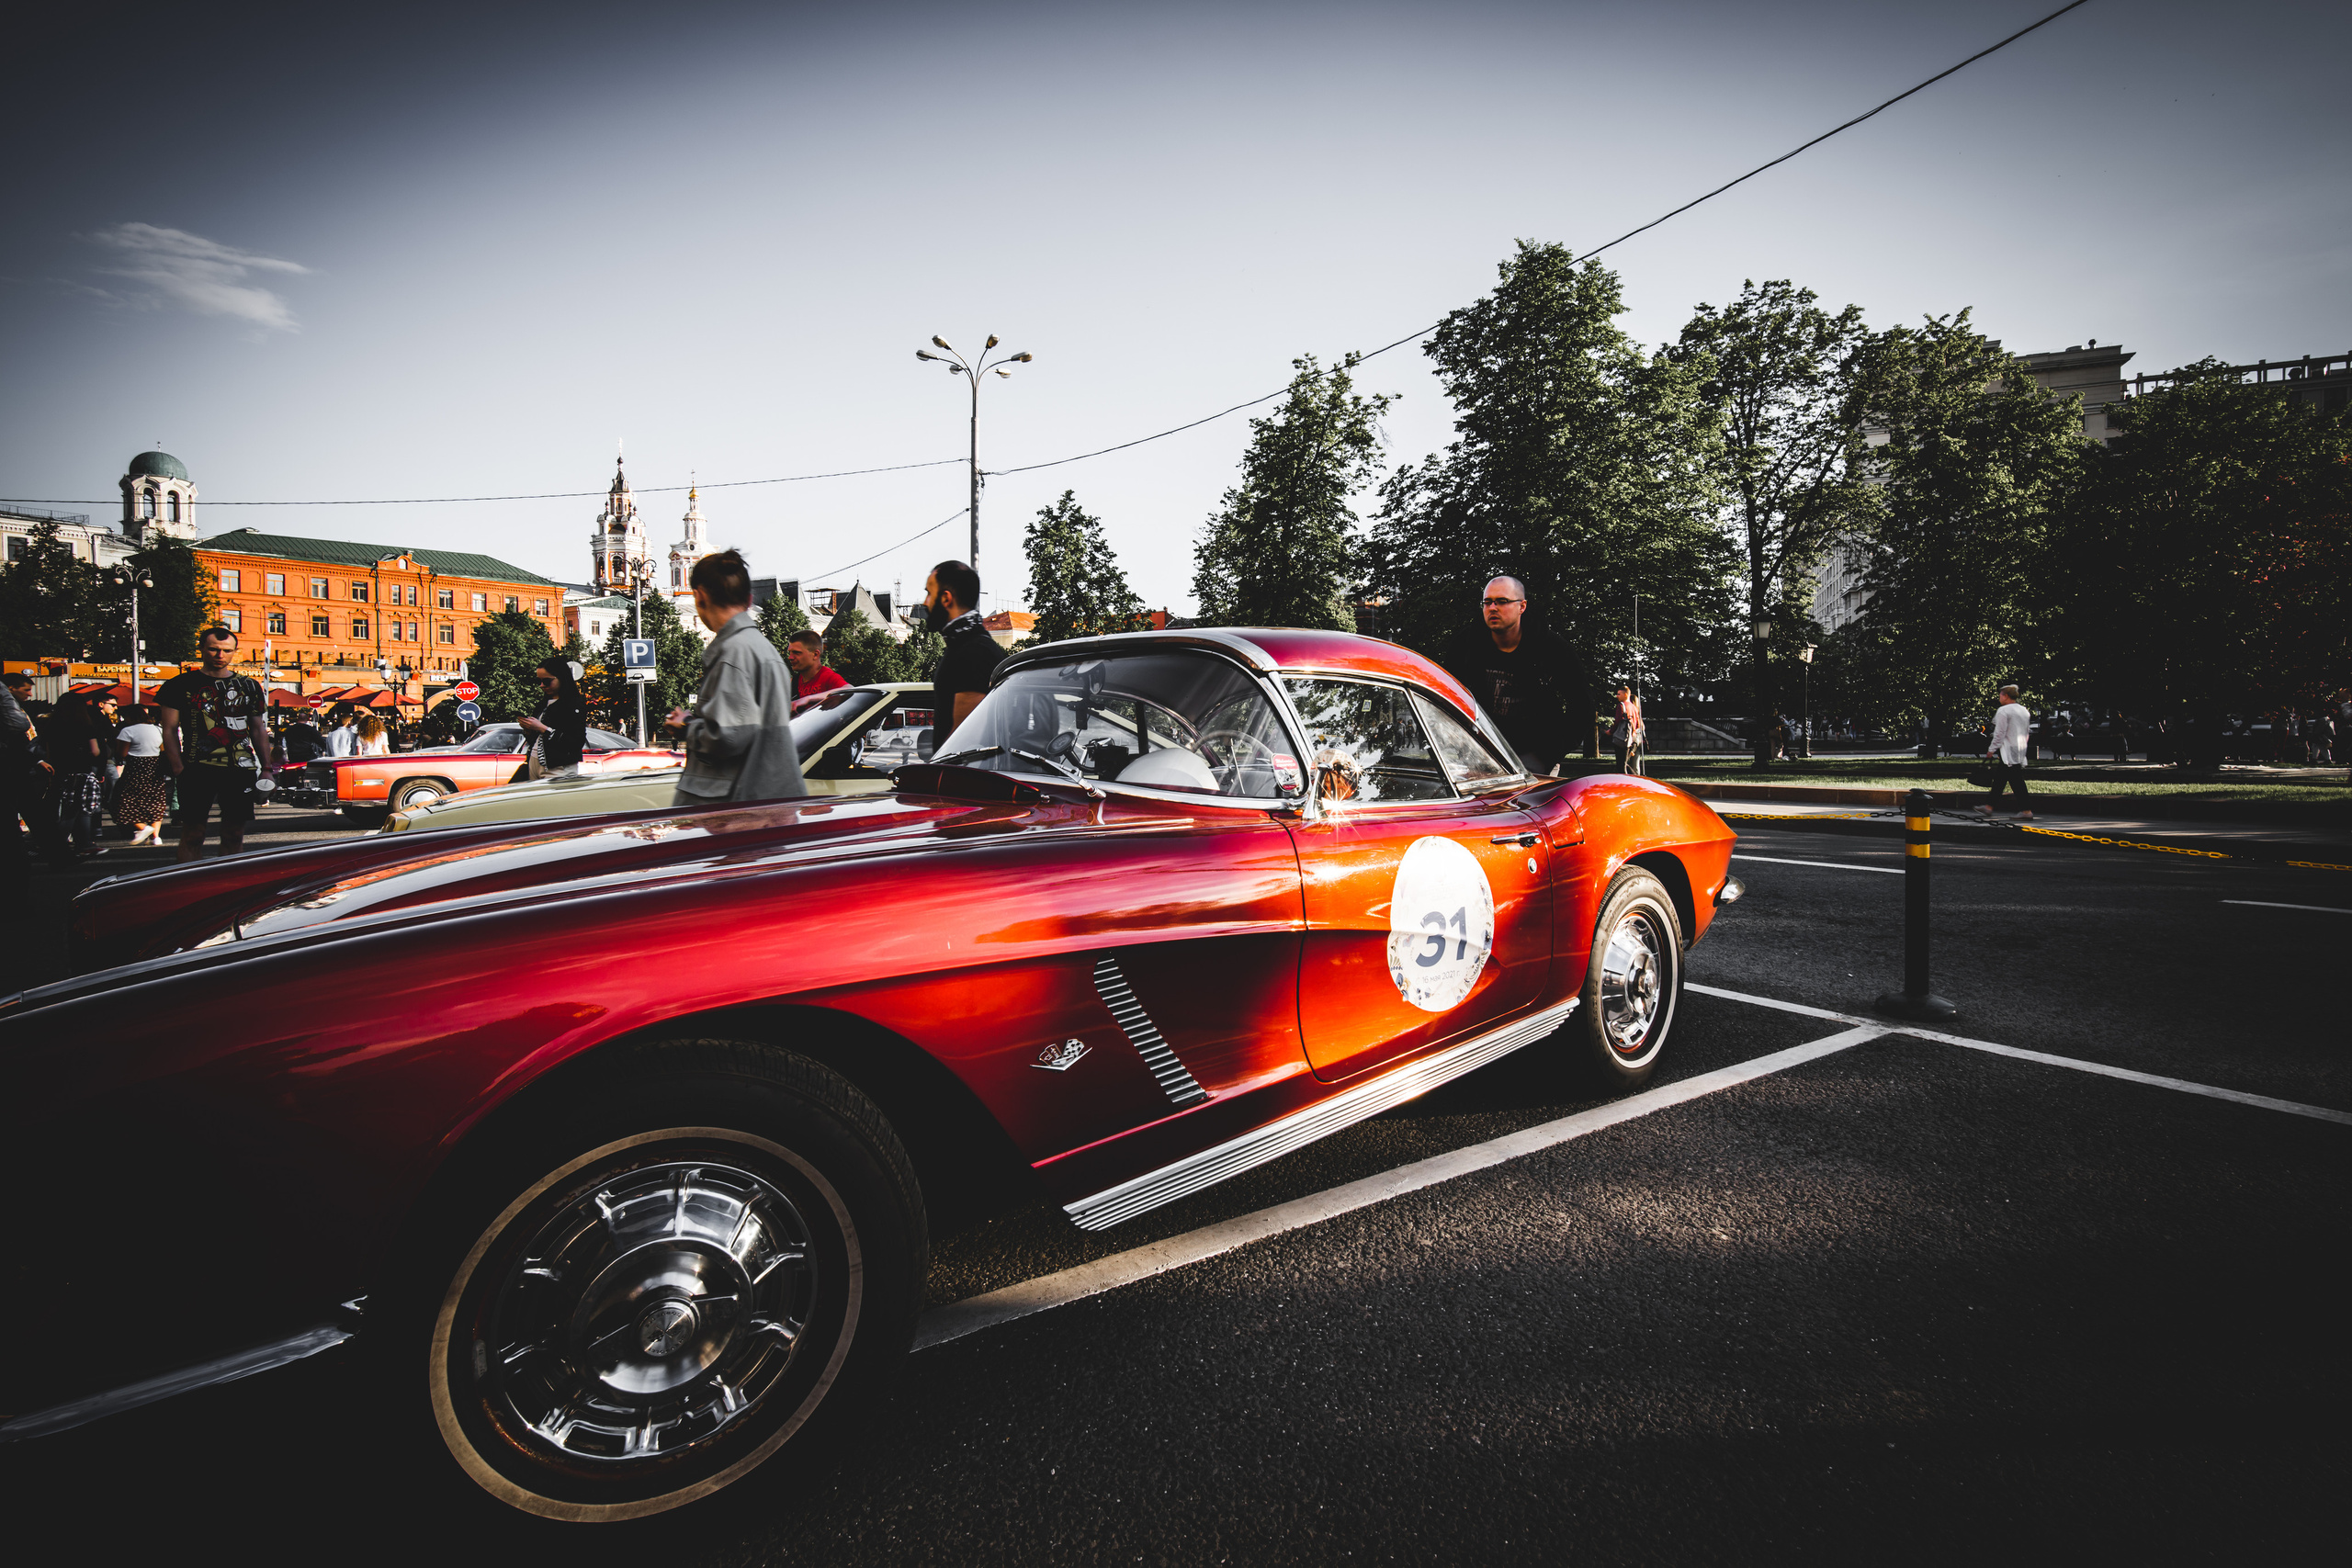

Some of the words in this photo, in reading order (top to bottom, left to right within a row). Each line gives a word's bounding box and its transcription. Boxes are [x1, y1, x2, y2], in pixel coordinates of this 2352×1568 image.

[631, 642, 649, 664] P
[456, 687, 478, 695] STOP
[1415, 907, 1467, 967] 31
